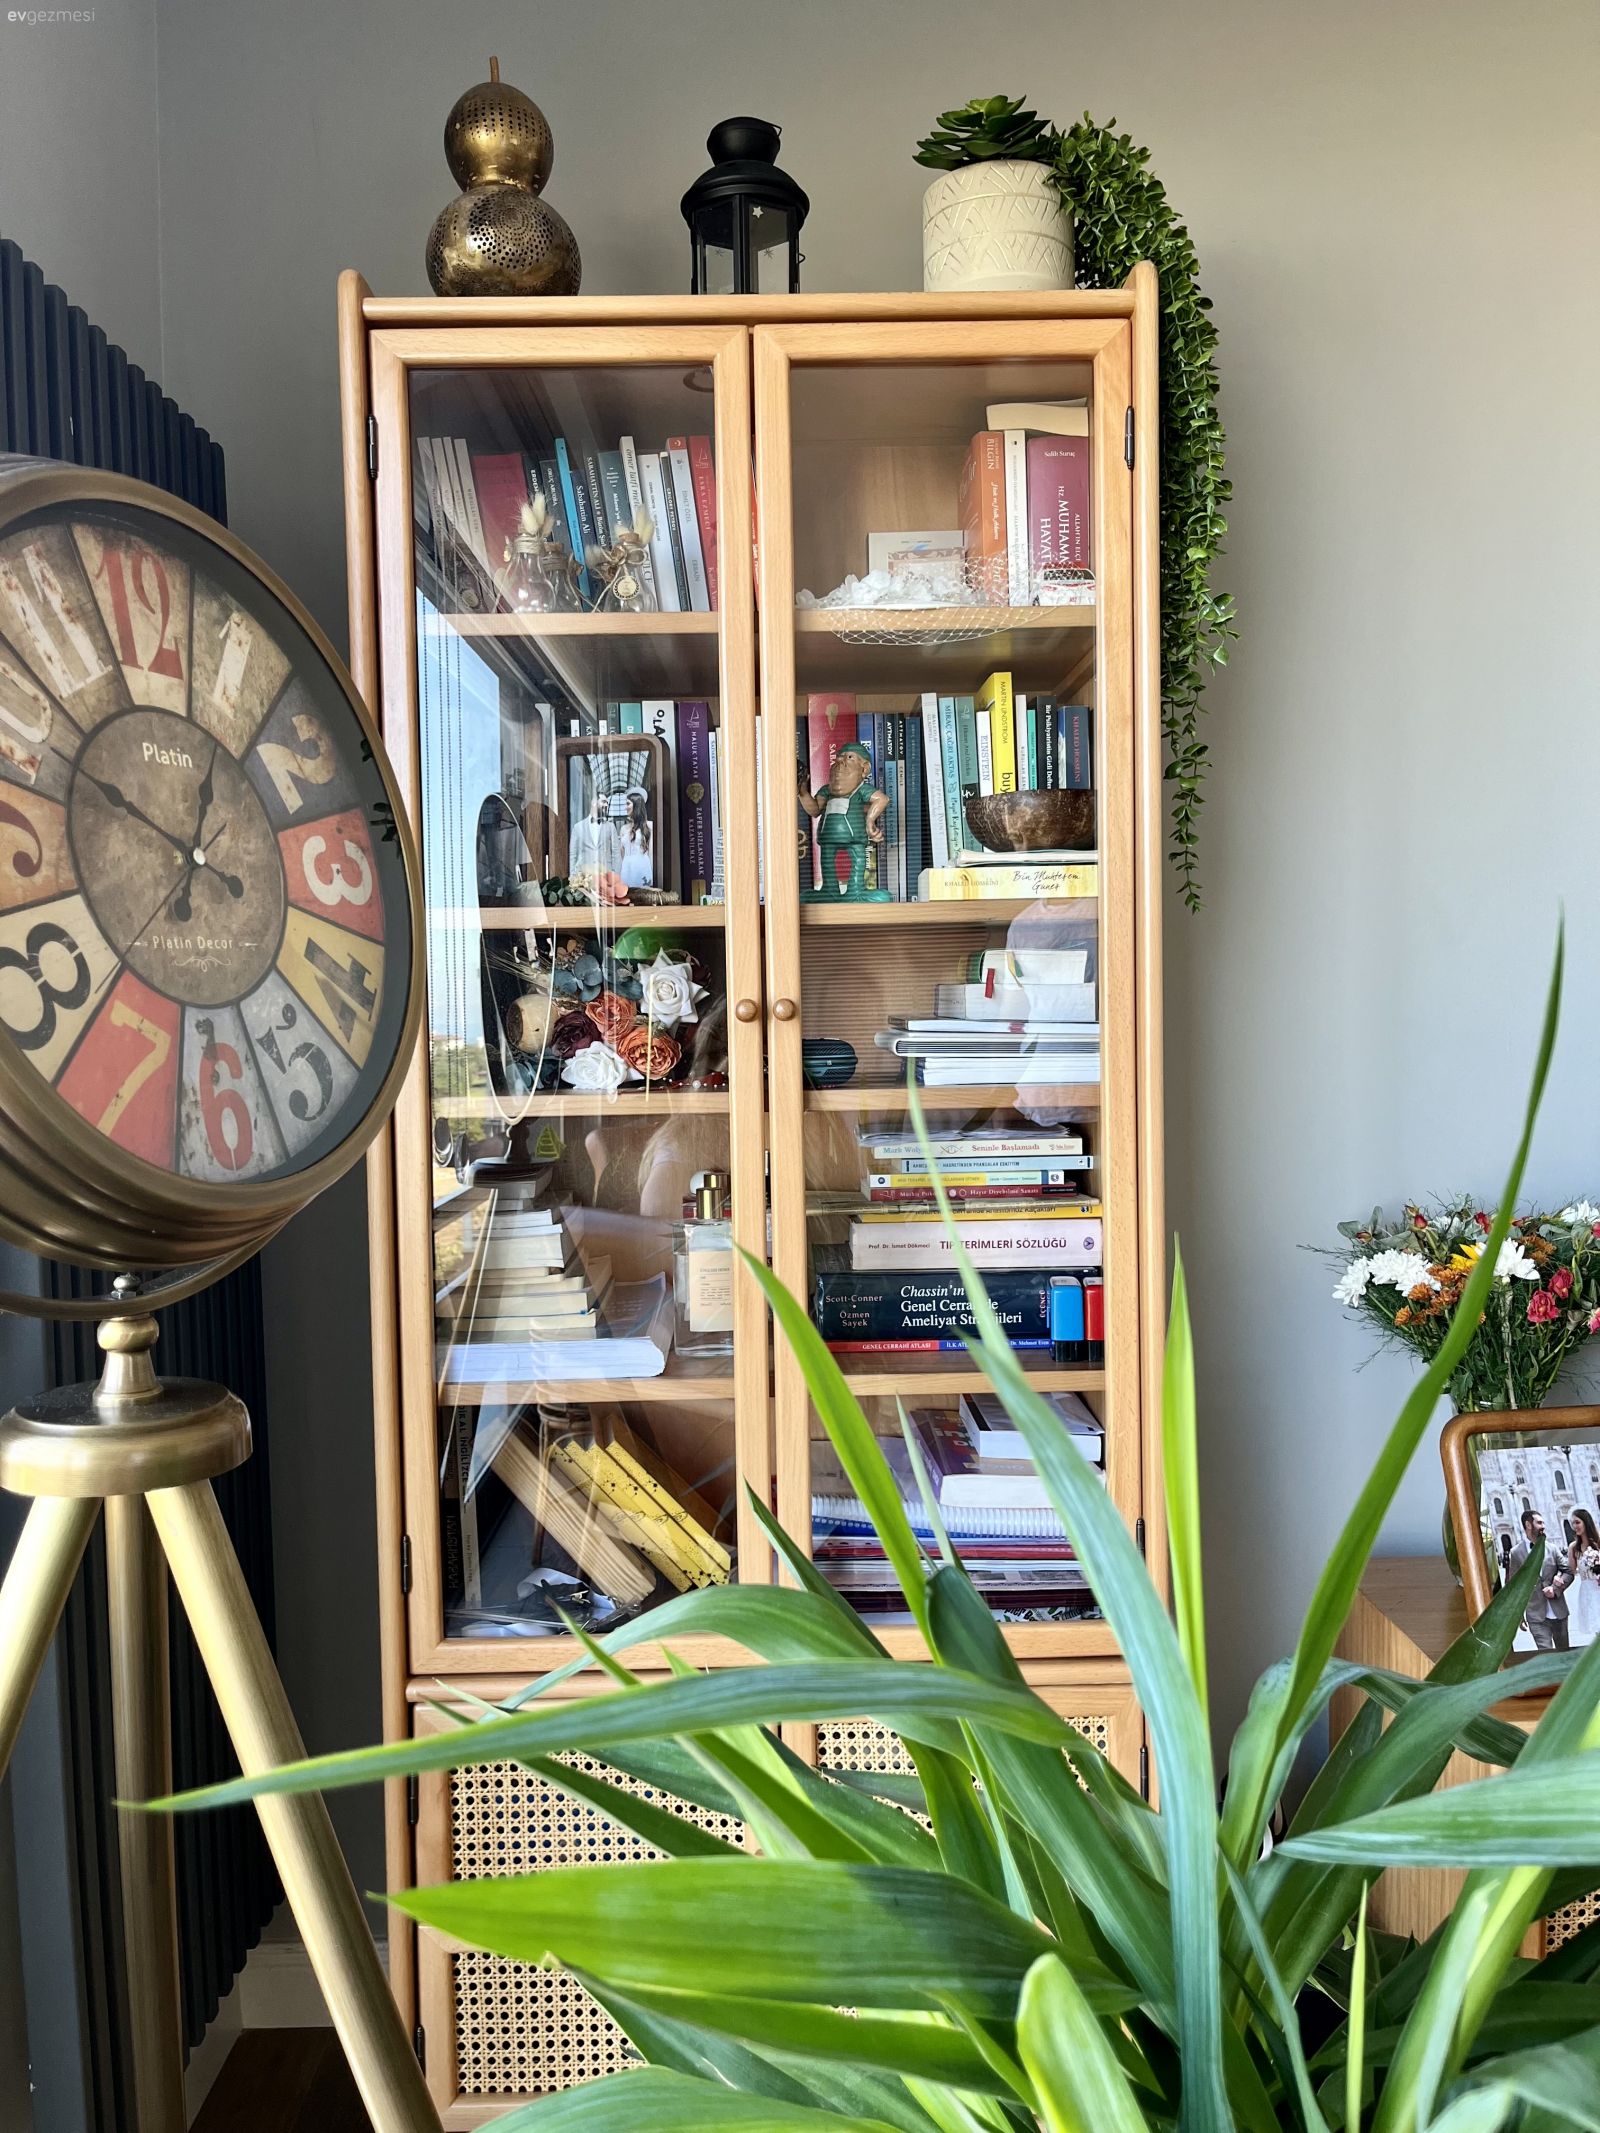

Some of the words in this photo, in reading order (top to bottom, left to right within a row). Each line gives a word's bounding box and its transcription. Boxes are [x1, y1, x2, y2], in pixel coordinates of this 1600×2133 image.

[577, 485, 588, 522] Sabahattin
[583, 522, 591, 535] Ali
[95, 543, 184, 681] 12
[212, 609, 252, 720] 1
[690, 731, 699, 754] HALUK
[885, 721, 894, 756] AYTMATOV
[1001, 706, 1009, 744] LINDSTROM
[1045, 715, 1053, 755] Psikiyatristin
[142, 741, 193, 769] Platin
[256, 712, 339, 815] 2
[980, 735, 991, 781] EINSTEIN
[688, 818, 697, 865] KAZANILMAZ
[697, 831, 705, 876] SIZLANARAK
[302, 834, 373, 907] 3
[1012, 870, 1031, 881] Bin
[152, 935, 192, 950] Platin
[197, 935, 233, 950] Decor
[0, 921, 91, 1051] 8
[303, 936, 378, 1043] 4
[98, 999, 172, 1138] 7
[255, 1003, 334, 1122] 5
[198, 1041, 254, 1172] 6
[883, 1146, 903, 1154] Mark
[971, 1144, 999, 1152] Seninle
[970, 1189, 986, 1197] Hayır
[1016, 1237, 1067, 1249] SÖZLÜĞÜ
[825, 1294, 883, 1304] Scott-Conner
[900, 1284, 965, 1298] Chassin'ın
[900, 1300, 936, 1313] Genel
[839, 1311, 870, 1320] Özmen
[842, 1319, 868, 1328] Sayek
[901, 1315, 957, 1330] Ameliyat
[883, 1342, 910, 1350] CERRAHİ
[910, 1341, 931, 1349] ATLASI
[946, 1340, 957, 1348] İLK
[1018, 1338, 1037, 1346] Mehmet
[459, 1436, 469, 1482] İNGİLİZCE
